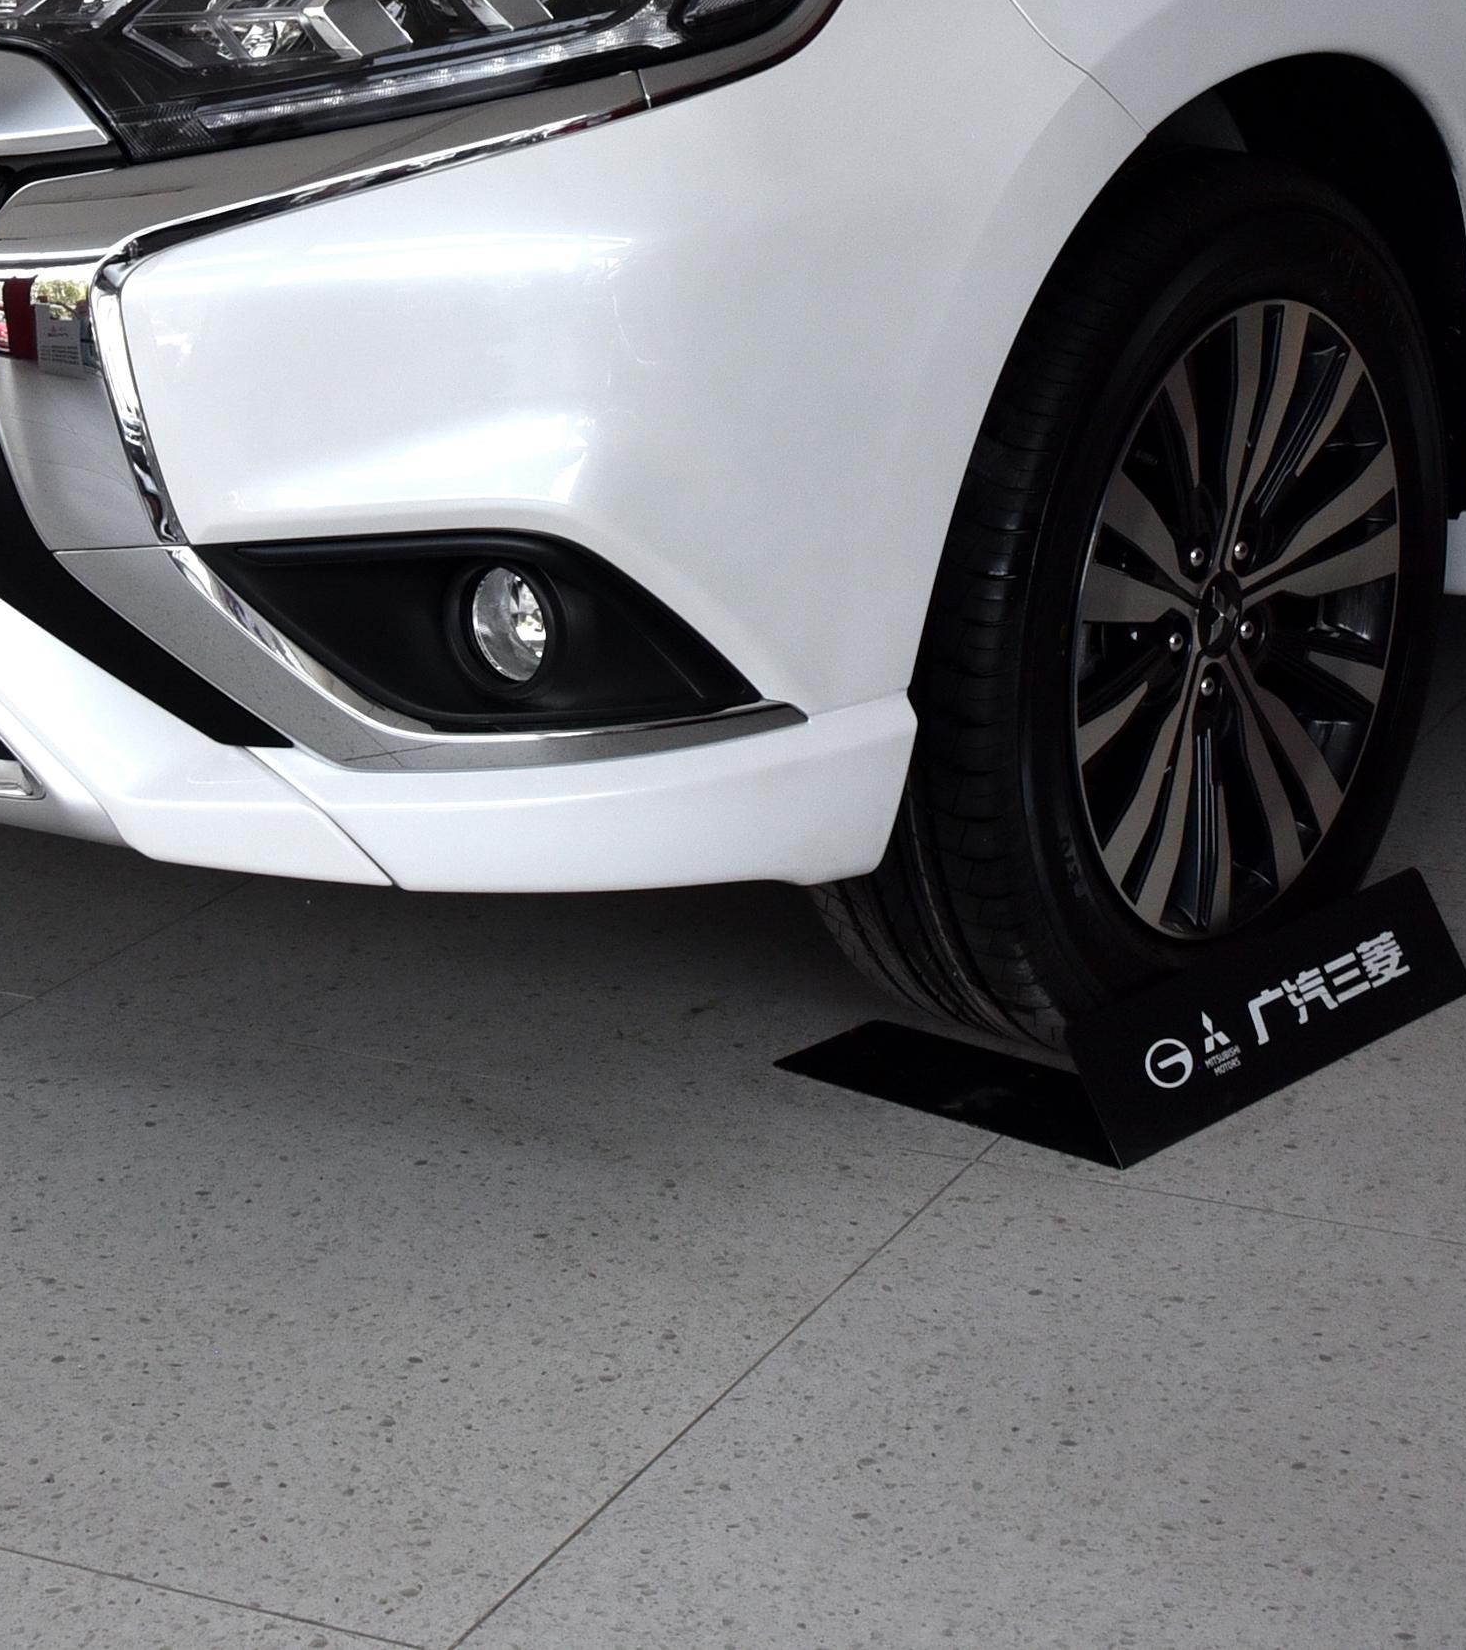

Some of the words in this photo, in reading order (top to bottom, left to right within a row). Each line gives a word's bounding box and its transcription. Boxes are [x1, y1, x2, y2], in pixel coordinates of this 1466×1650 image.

[1248, 930, 1411, 1046] 广汽三菱
[1204, 1045, 1242, 1070] MITSUBISHI
[1214, 1057, 1242, 1077] MOTORS
